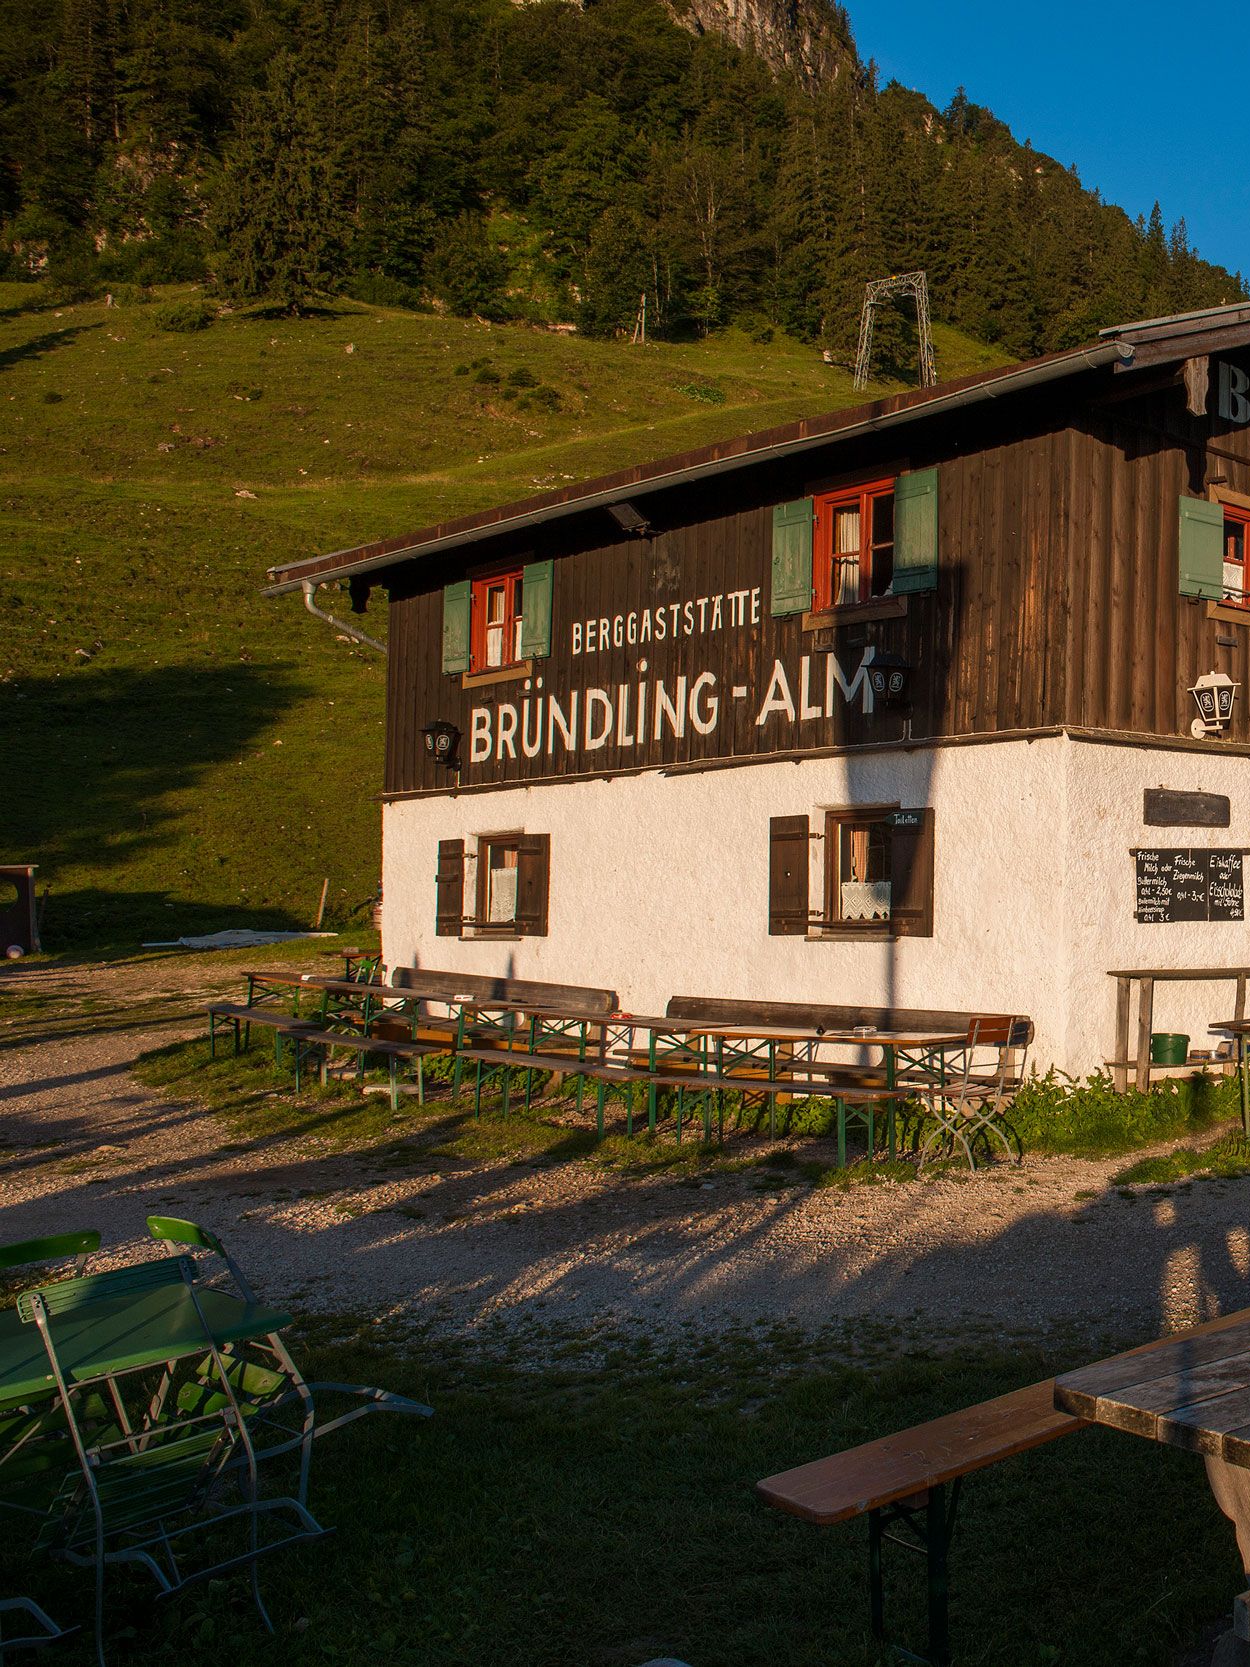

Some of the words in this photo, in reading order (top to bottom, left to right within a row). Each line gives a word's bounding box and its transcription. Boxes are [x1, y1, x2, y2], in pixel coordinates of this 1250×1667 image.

[572, 587, 760, 655] BERGGASTSTÄTTE
[469, 646, 875, 763] BRÜNDLING-ALM
[1137, 851, 1160, 862] Frische
[1174, 855, 1196, 868] Frische
[1144, 862, 1159, 875] Milch
[1161, 863, 1173, 872] oder
[1209, 854, 1242, 873] Eiskaffee
[1173, 869, 1204, 883] Ziegenmilch
[1219, 872, 1232, 880] oder
